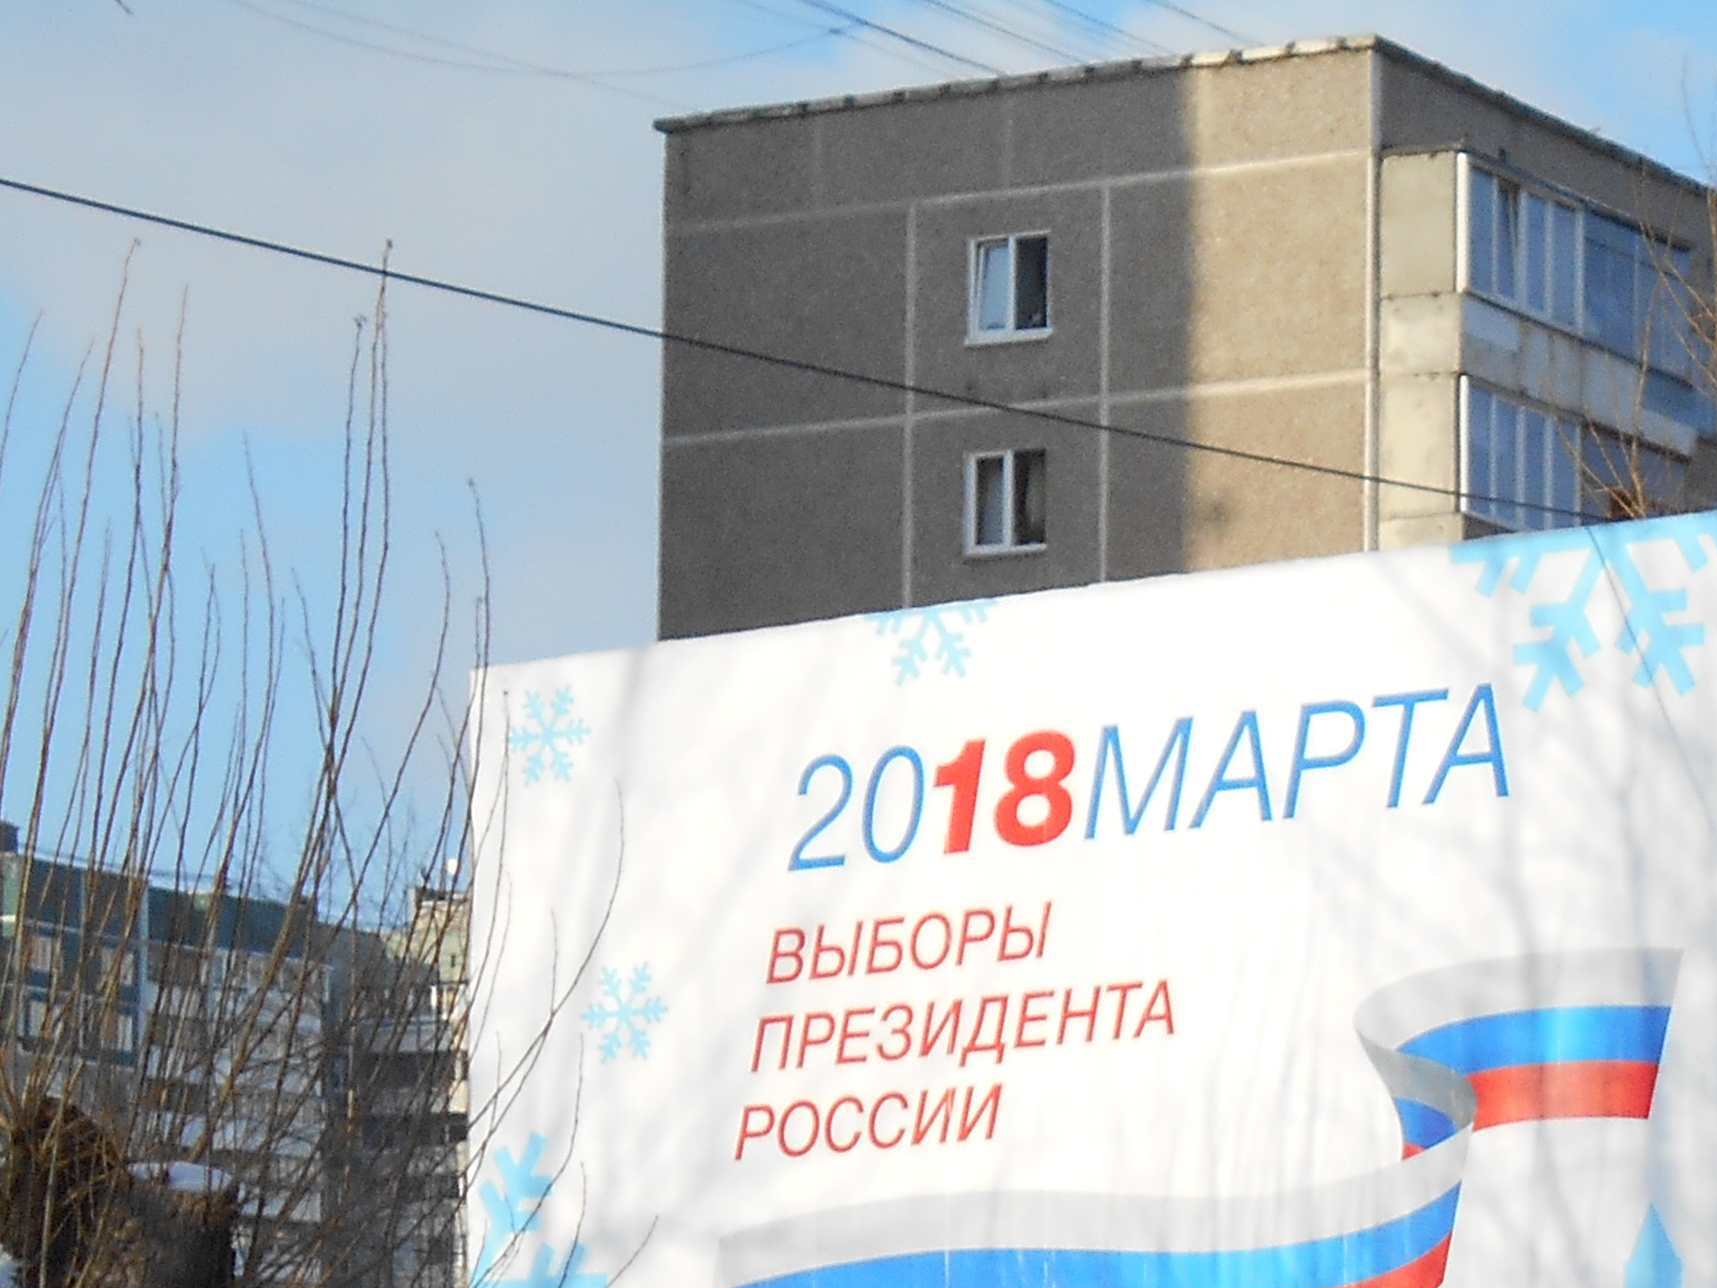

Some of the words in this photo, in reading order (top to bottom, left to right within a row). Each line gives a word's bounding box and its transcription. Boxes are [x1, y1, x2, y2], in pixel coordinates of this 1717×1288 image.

[765, 901, 1053, 985] ВЫБОРЫ
[750, 979, 1176, 1073] ПРЕЗИДЕНТА
[734, 1083, 1004, 1160] РОССИИ
